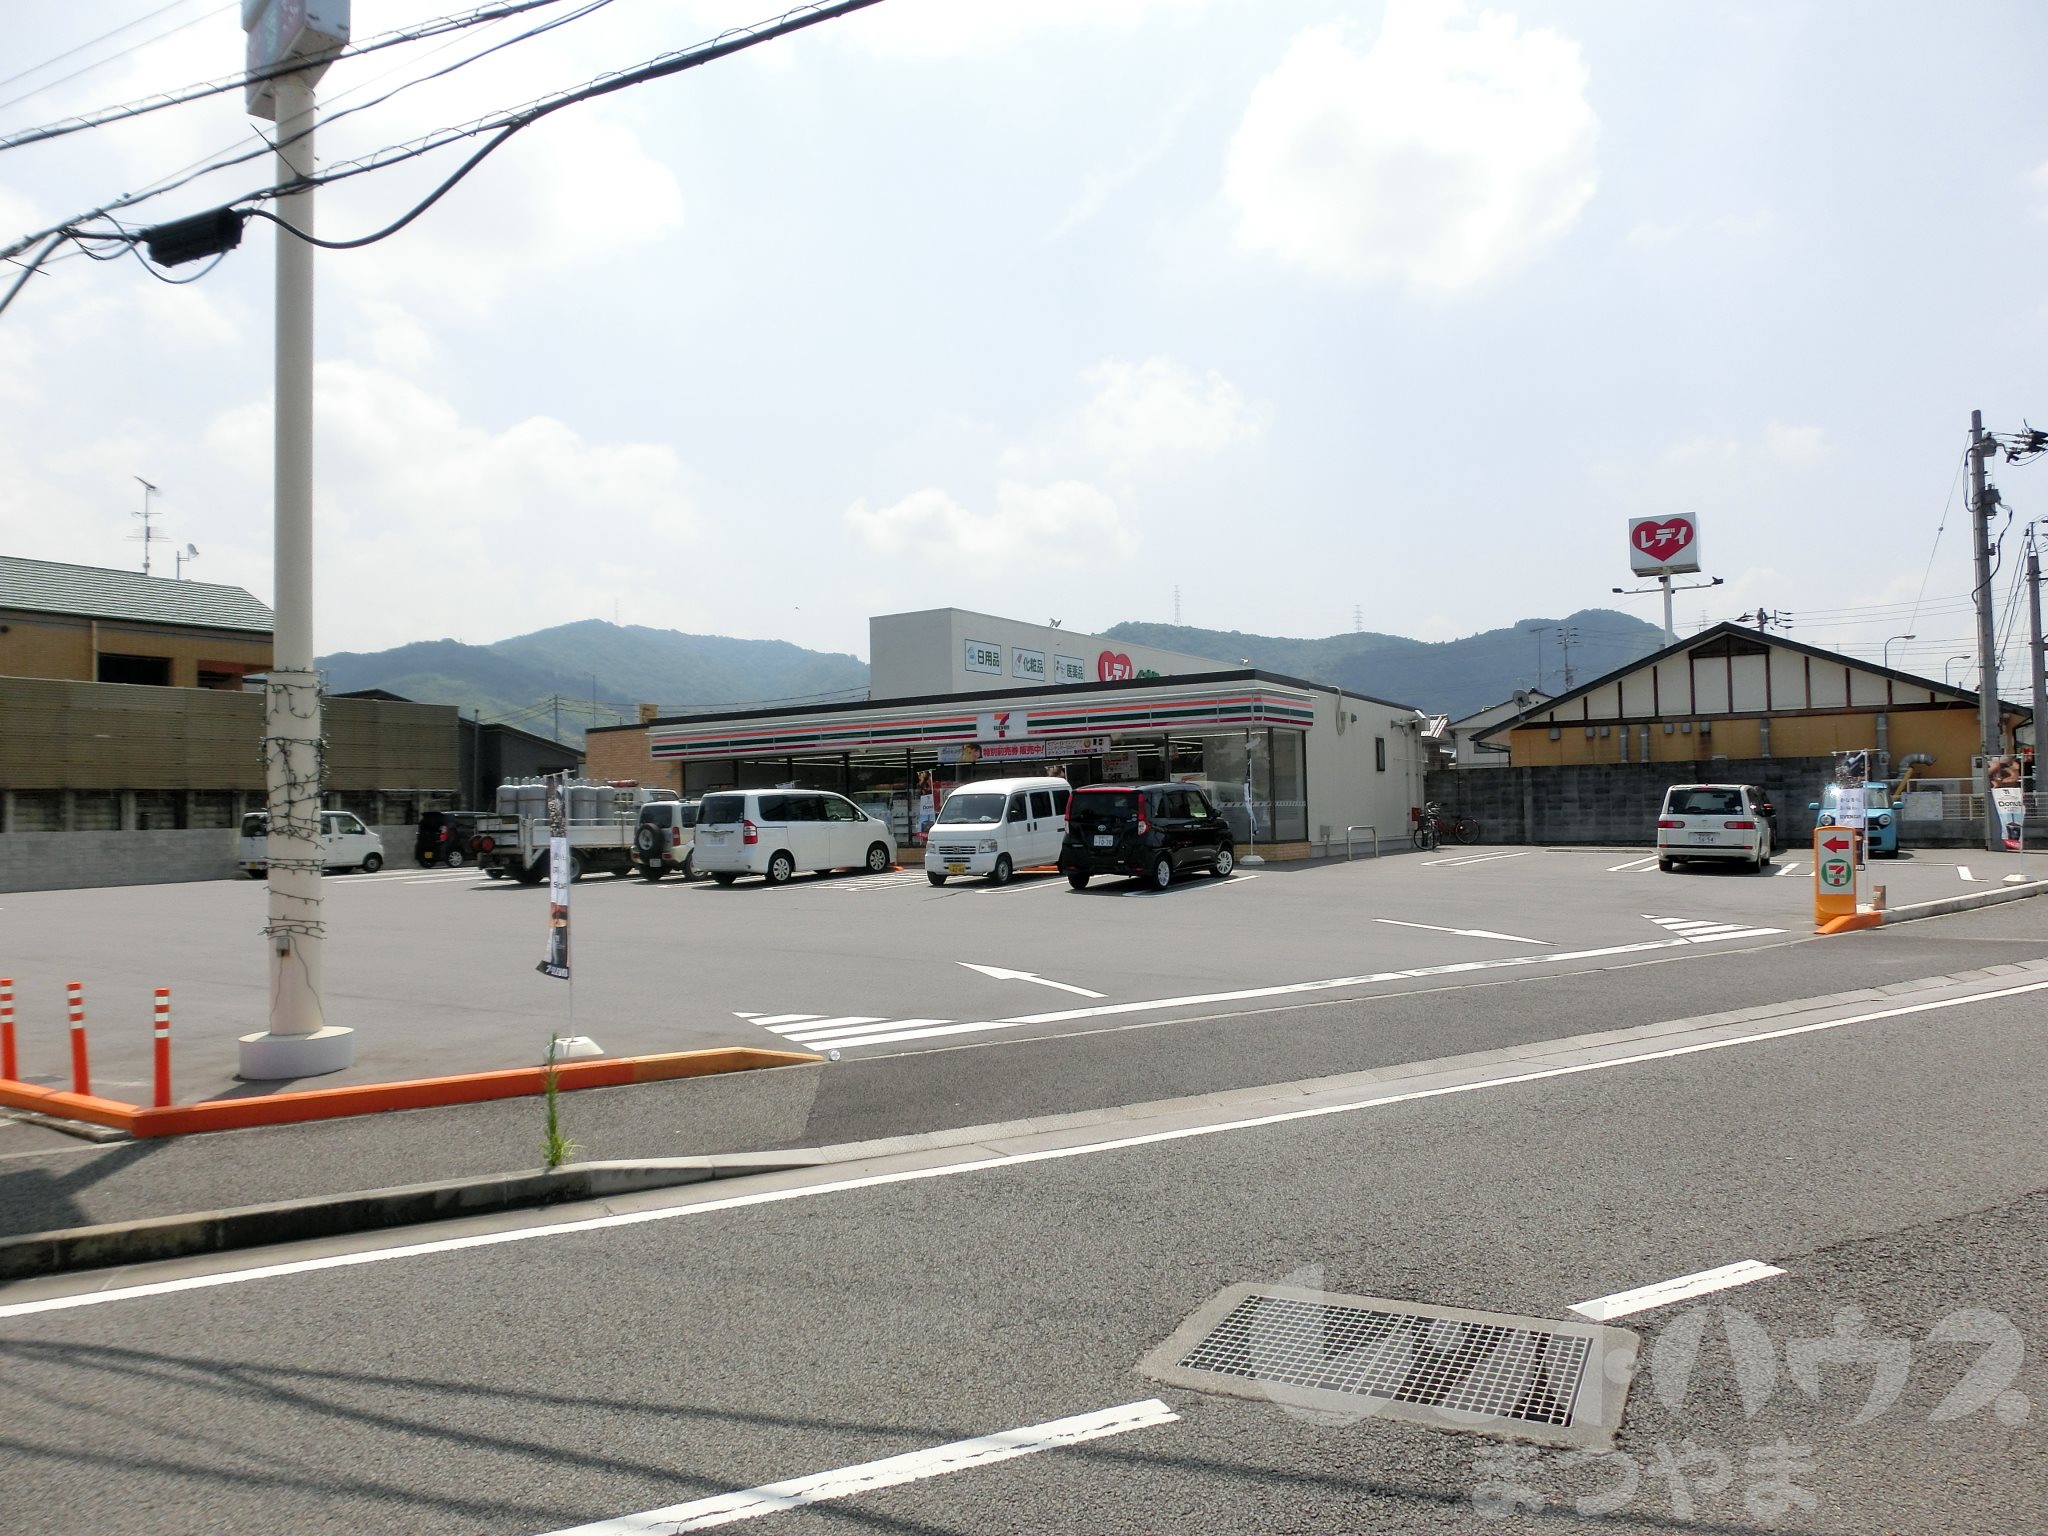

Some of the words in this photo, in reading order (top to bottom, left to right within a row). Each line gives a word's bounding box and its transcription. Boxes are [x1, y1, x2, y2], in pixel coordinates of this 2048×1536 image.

[977, 650, 1000, 667] 日用品
[1023, 656, 1044, 673] 化粧品
[1066, 663, 1085, 680] 医薬品
[994, 713, 1010, 738] 7
[1828, 864, 1845, 885] 7
